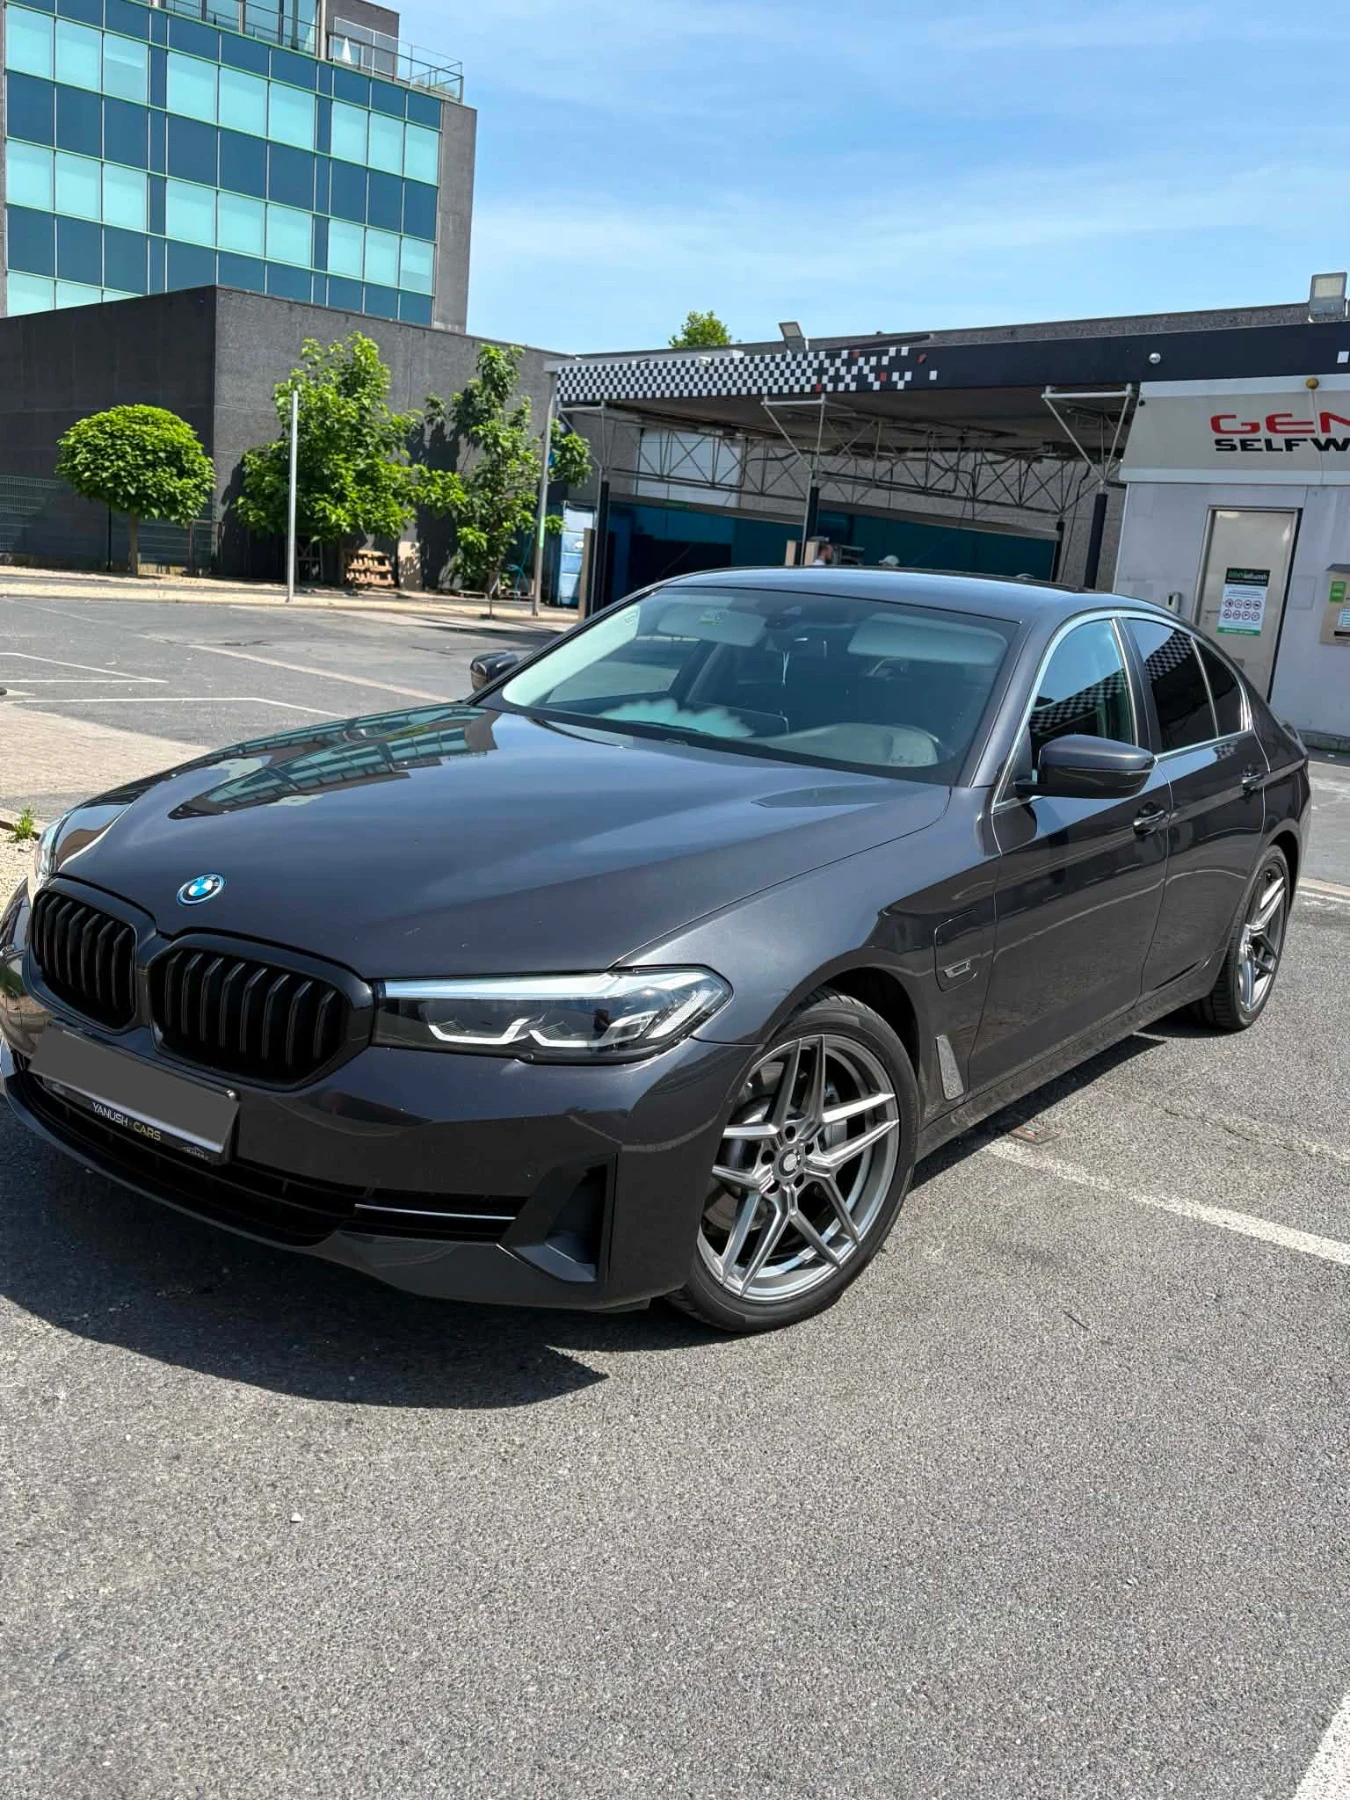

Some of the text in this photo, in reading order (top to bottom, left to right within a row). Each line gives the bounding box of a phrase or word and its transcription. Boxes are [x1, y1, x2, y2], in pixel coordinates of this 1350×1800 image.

[1214, 438, 1350, 452] SELFW
[92, 1102, 162, 1141] YANUSH CARS
